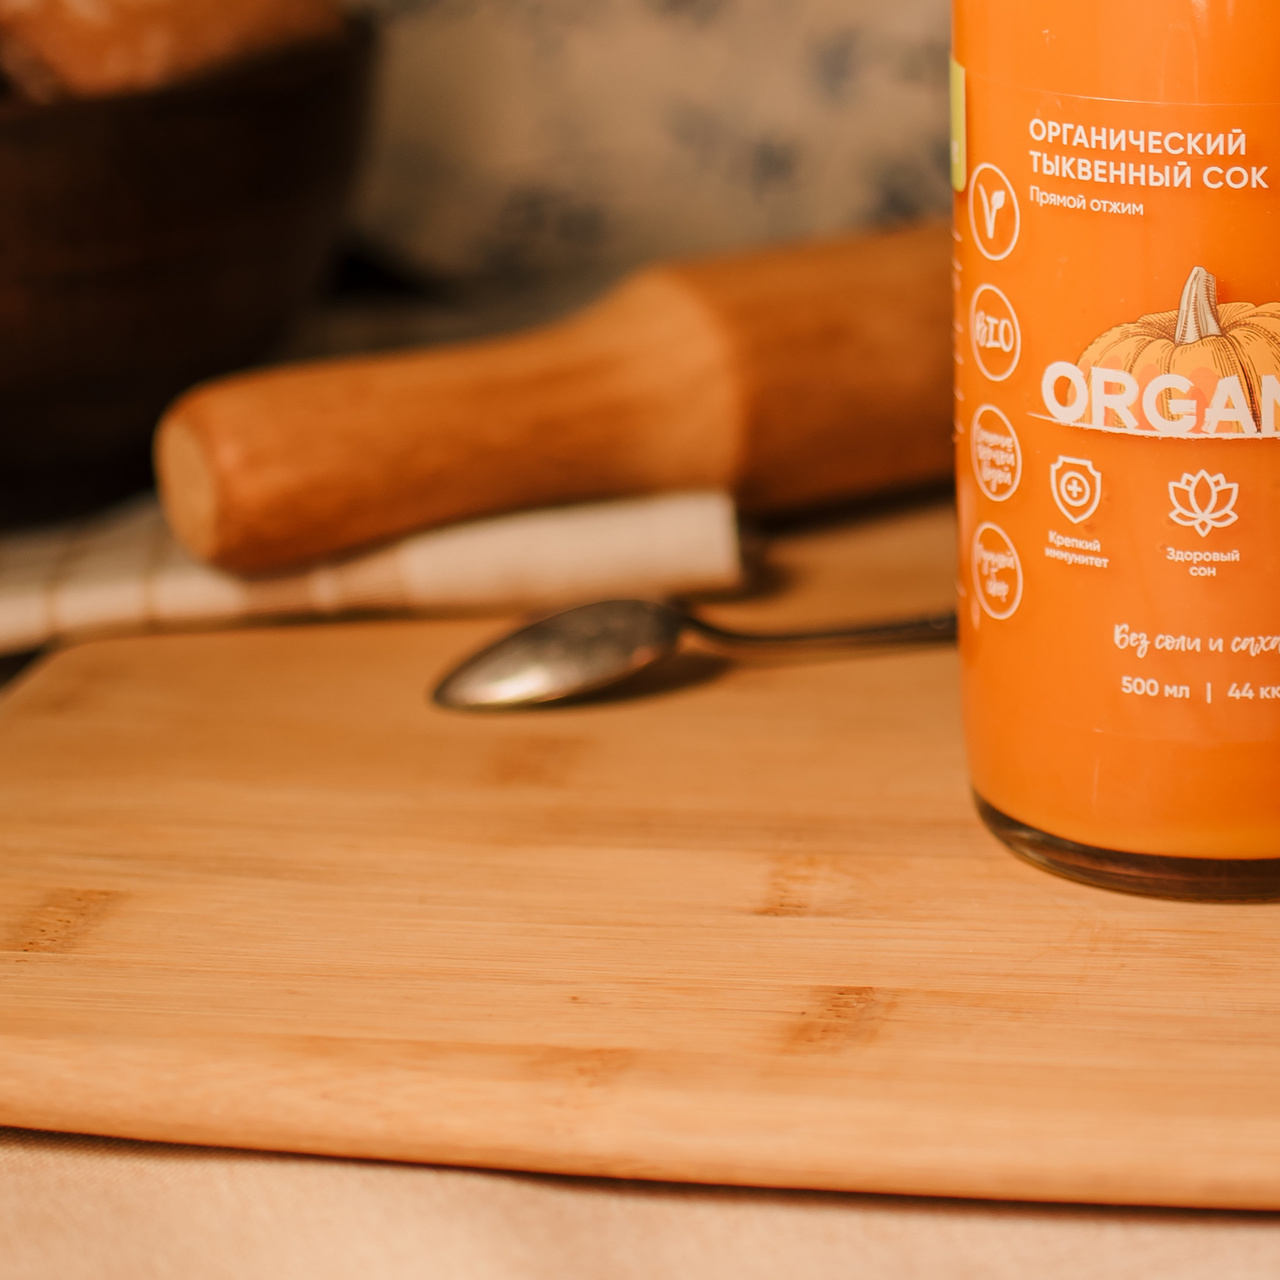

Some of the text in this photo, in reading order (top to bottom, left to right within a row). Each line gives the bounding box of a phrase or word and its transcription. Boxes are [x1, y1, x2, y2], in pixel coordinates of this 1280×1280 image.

[1028, 118, 1247, 156] ОРГАНИЧЕСКИЙ
[1028, 150, 1269, 190] ТЫКВЕННЫЙ СОК
[1029, 185, 1144, 216] Прямой отжим
[1047, 529, 1101, 552] Крепкий
[1044, 545, 1110, 569] иммунитет
[1165, 546, 1241, 564] Здоровый
[1188, 564, 1217, 577] сон
[1113, 623, 1151, 659] Без
[1154, 633, 1202, 653] соли
[1208, 636, 1224, 653] и
[1121, 675, 1160, 697] 500
[1164, 683, 1190, 699] мл
[1227, 682, 1255, 700] 44
